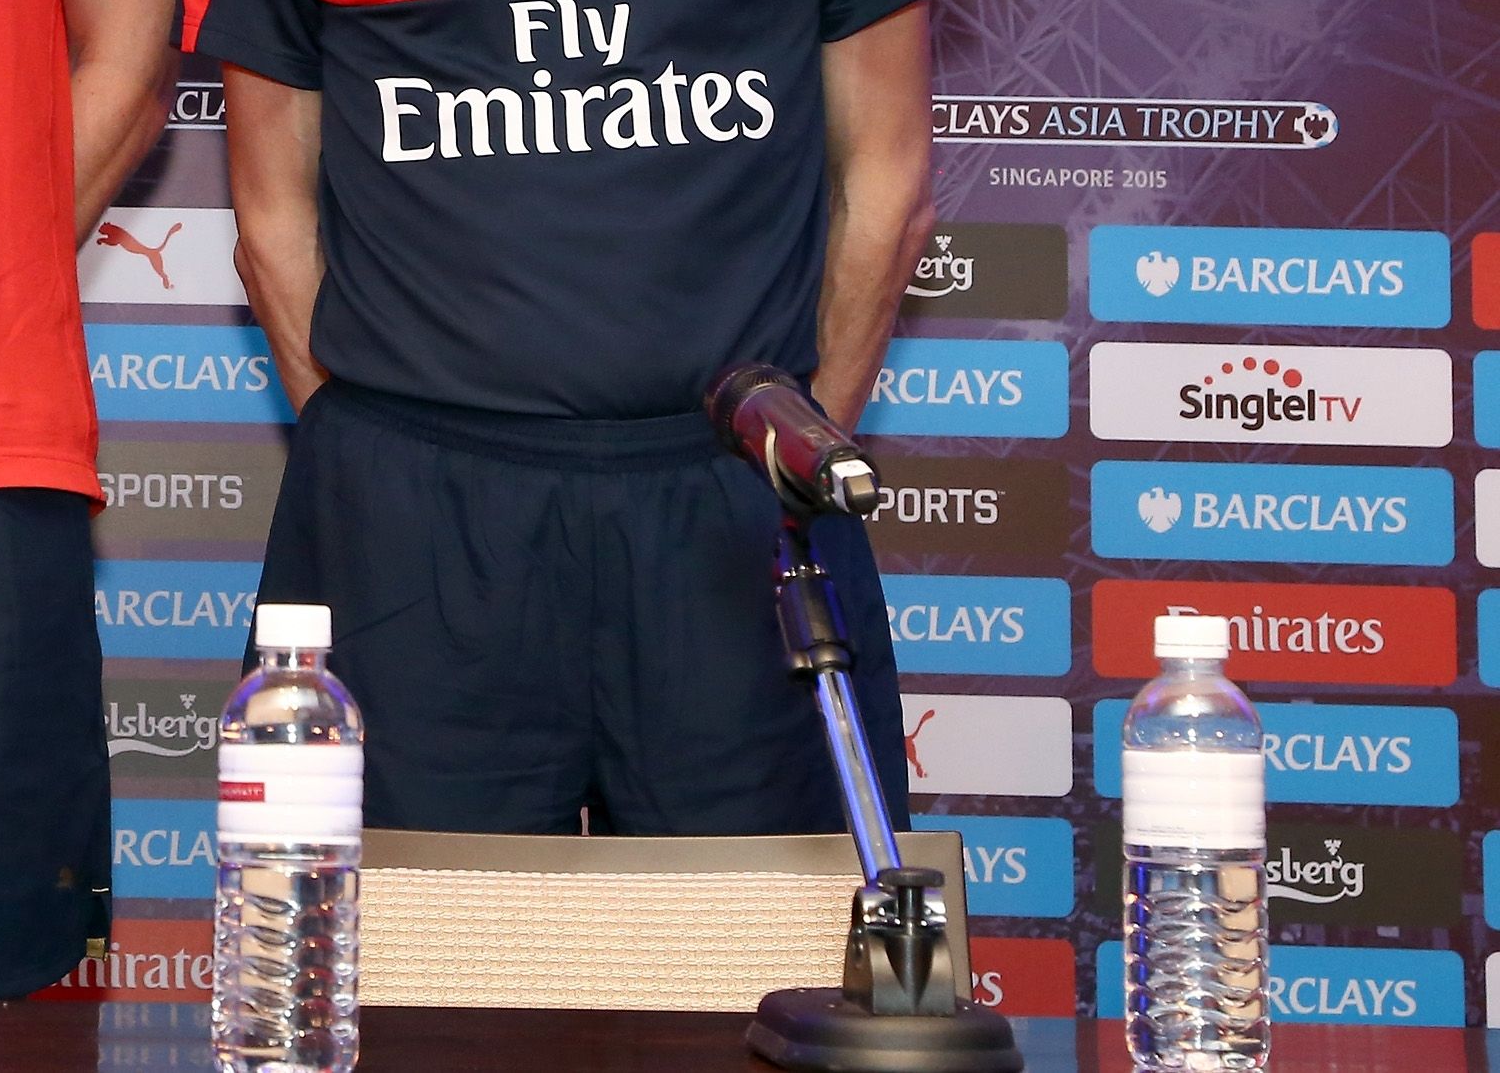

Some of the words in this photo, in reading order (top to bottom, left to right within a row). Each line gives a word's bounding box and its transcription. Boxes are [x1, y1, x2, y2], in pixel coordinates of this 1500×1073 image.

[509, 0, 629, 66] Fly
[375, 62, 774, 162] Emirates
[932, 104, 1029, 134] CLAYS
[1040, 107, 1126, 136] ASIA
[1137, 108, 1284, 138] TROPHY
[990, 168, 1113, 187] SINGAPORE
[1123, 170, 1166, 188] 2015
[1191, 257, 1403, 296] BARCLAYS
[92, 354, 268, 391] ARCLAYS
[871, 369, 1023, 405] RCLAYS
[871, 488, 997, 524] PORTS
[1193, 493, 1406, 532] BARCLAYS
[96, 591, 257, 627] ARCLAYS
[105, 698, 218, 757] lsberg
[1263, 735, 1411, 773] RCLAYS
[113, 829, 216, 867] RCLA
[1266, 844, 1364, 900] sberg
[61, 942, 213, 989] mirate
[1270, 978, 1417, 1017] RCLAYS
